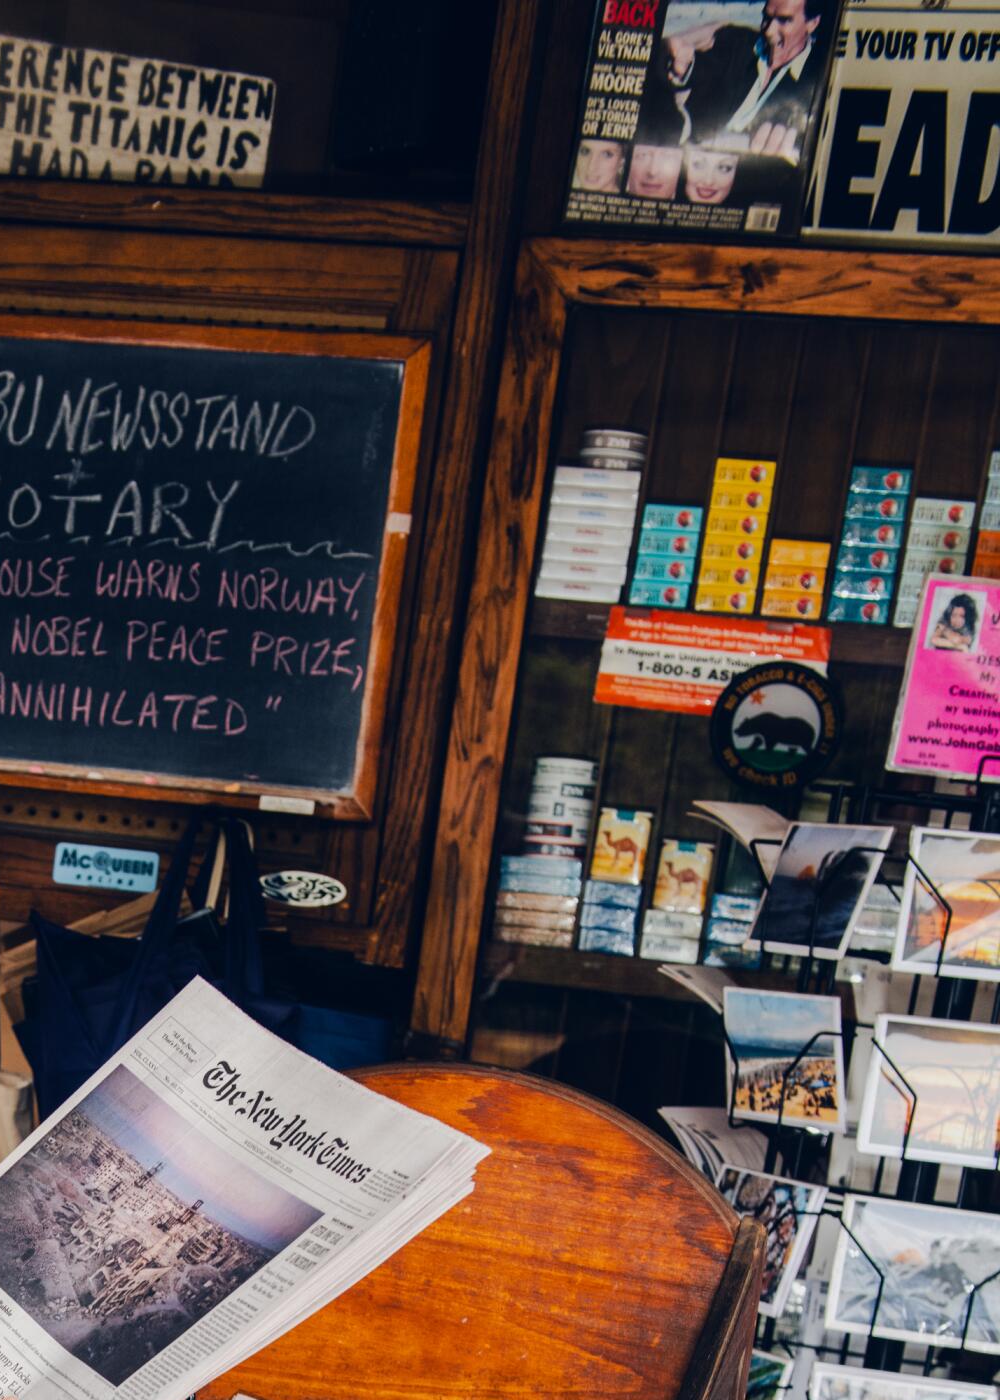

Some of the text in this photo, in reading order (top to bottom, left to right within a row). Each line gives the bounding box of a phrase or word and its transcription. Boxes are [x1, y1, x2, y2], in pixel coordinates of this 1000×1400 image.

[602, 0, 658, 28] BACK
[597, 43, 652, 62] VIETNAM
[855, 29, 918, 60] YOUR
[923, 30, 953, 61] TV
[138, 61, 274, 122] BETWEEN
[589, 73, 645, 96] MOORE
[582, 121, 599, 136] OR
[584, 109, 639, 125] HISTORIAN
[68, 100, 208, 160] TITANIC
[215, 126, 260, 170] IS
[802, 88, 1000, 235] EAD
[45, 376, 318, 459] NEWSSTAND
[95, 557, 203, 604] WARNS
[217, 566, 366, 621] NORWAY,
[10, 615, 110, 658] NOBEL
[126, 618, 229, 665] PEACE
[250, 632, 365, 692] PRIZE,
[637, 660, 702, 679] 1-800-5
[202, 1060, 246, 1108] The
[235, 1090, 284, 1133] New
[270, 1114, 325, 1159] York
[316, 1137, 372, 1184] Times
[0, 1373, 9, 1384] in
[10, 1361, 32, 1386] Mocks
